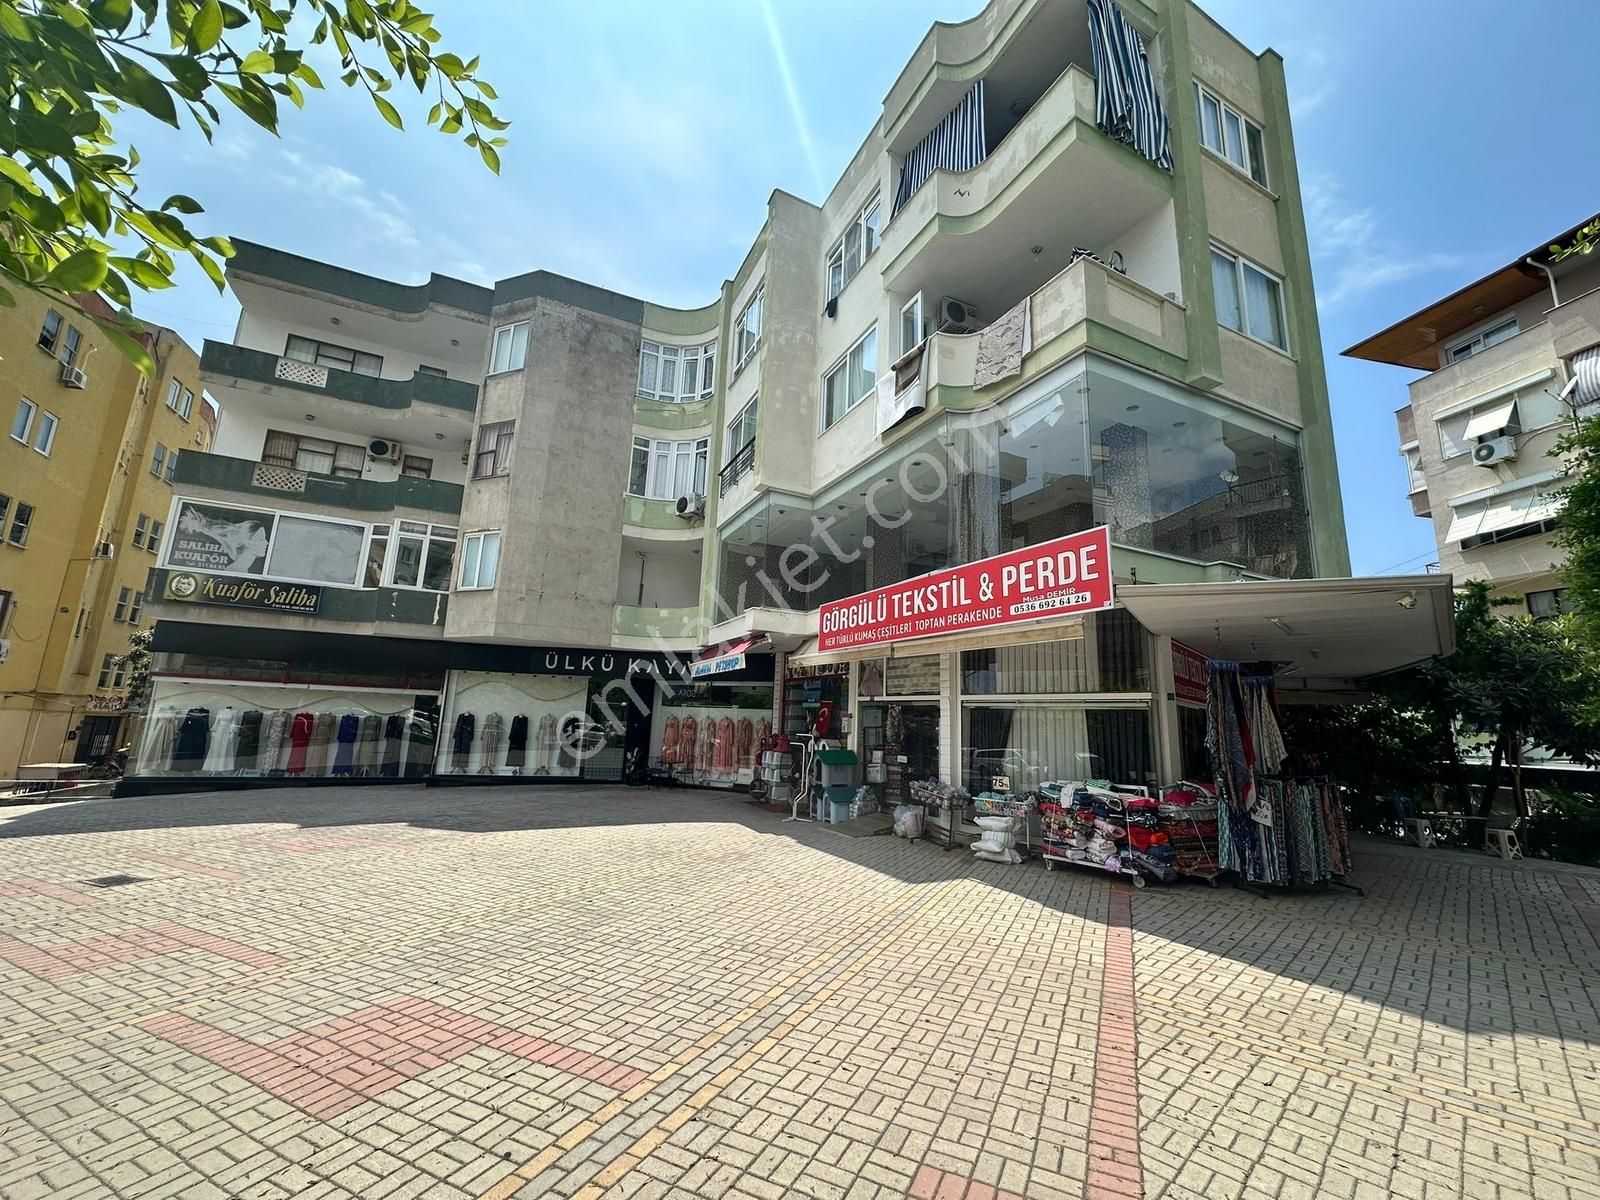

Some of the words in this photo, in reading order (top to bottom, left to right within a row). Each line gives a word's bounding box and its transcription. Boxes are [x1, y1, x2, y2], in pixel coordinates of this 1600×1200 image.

[174, 550, 228, 564] KUAFÖR
[203, 577, 264, 602] Kuaför
[264, 585, 317, 607] Saliha
[822, 594, 887, 633] GÖRGÜLÜ
[891, 574, 972, 619] TEKSTİL
[979, 572, 994, 602] &
[1002, 544, 1099, 597] PERDE
[1022, 593, 1044, 603] Musa
[1046, 586, 1076, 599] DEMİR
[1014, 604, 1036, 614] 0536
[1039, 599, 1056, 610] 692
[1059, 597, 1071, 606] 64
[1074, 595, 1087, 604] 26
[825, 637, 836, 647] HER
[836, 634, 854, 645] TÜRLÜ
[854, 629, 876, 643] KUMAŞ
[877, 621, 912, 640] ÇEŞİTLERİ
[915, 616, 945, 631] TOPTAN
[947, 606, 1002, 626] PERAKENDE
[545, 651, 614, 672] ÜLKÜ
[992, 778, 1004, 788] 75
